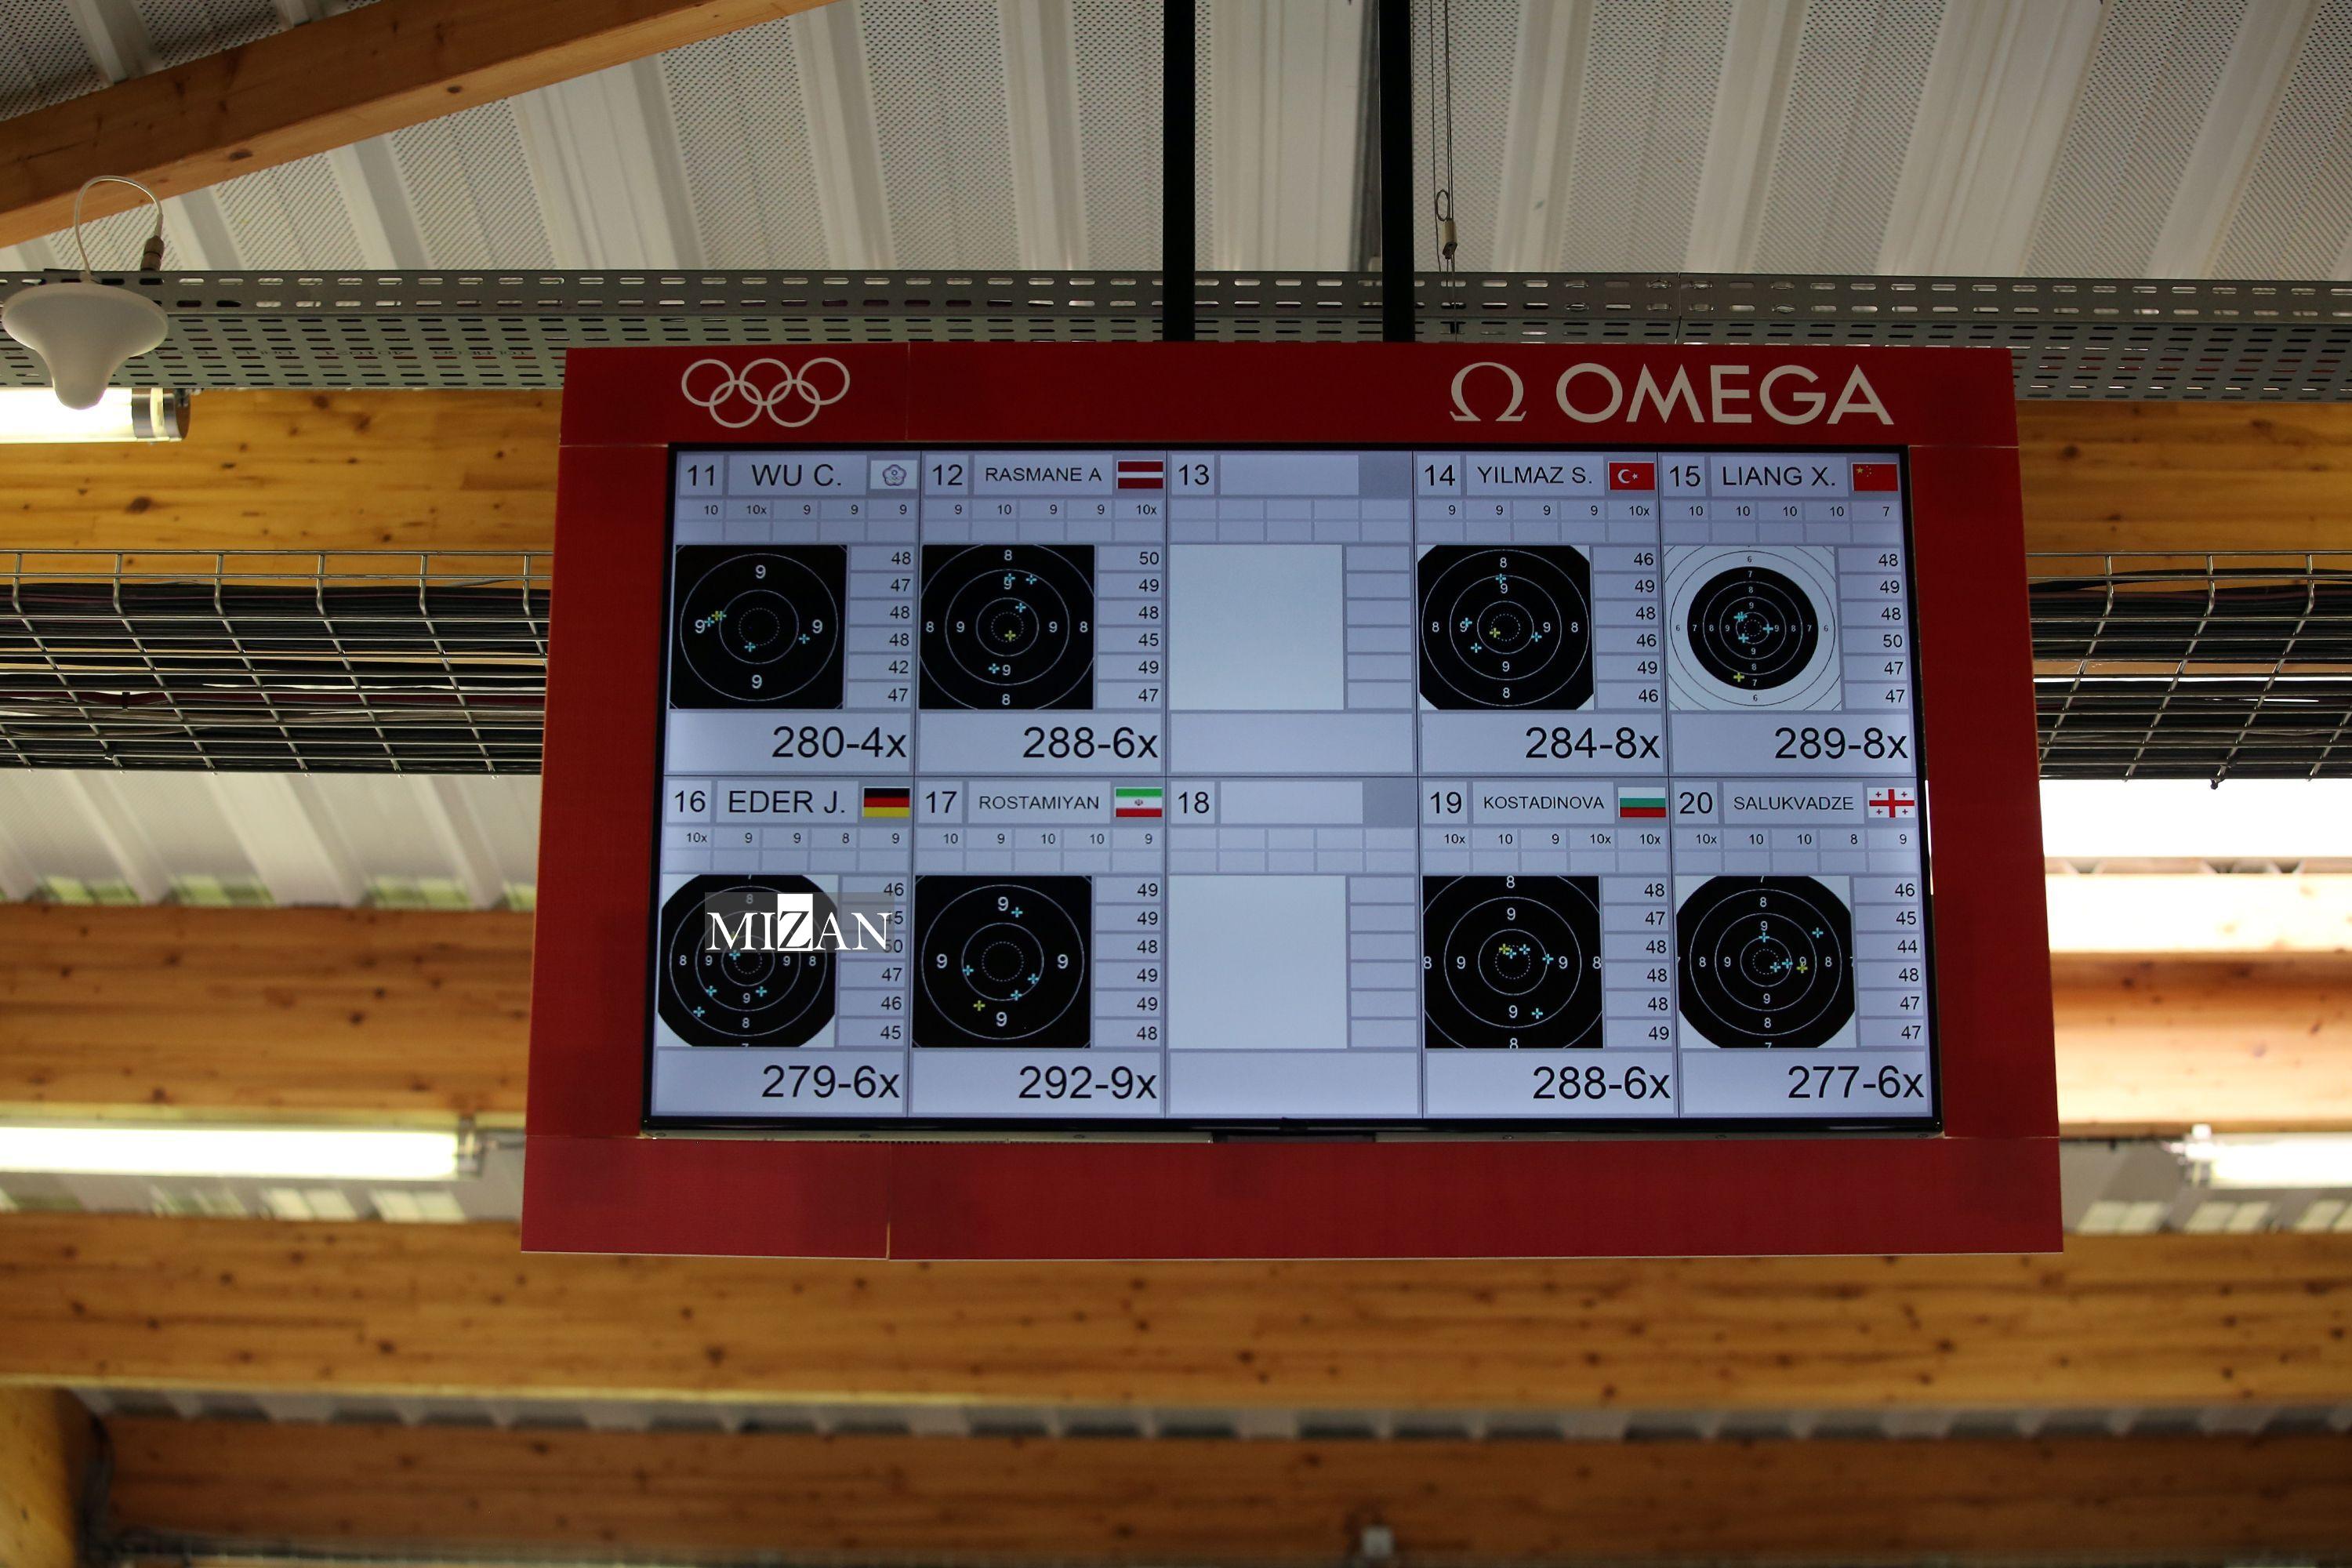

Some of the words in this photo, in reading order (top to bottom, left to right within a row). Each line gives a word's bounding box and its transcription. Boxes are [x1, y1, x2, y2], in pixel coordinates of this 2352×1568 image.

[1555, 362, 1895, 425] OMEGA
[688, 464, 714, 486] 11
[751, 464, 802, 487] WU
[814, 463, 841, 487] C.
[932, 463, 963, 486] 12
[985, 467, 1083, 481] RASMANE
[1088, 467, 1102, 481] A
[1178, 463, 1210, 486] 13
[1425, 464, 1456, 486] 14
[1477, 466, 1564, 484] YILMAZ
[1571, 466, 1592, 484] S.
[1669, 465, 1701, 488] 15
[1722, 466, 1802, 486] LIANG
[1811, 466, 1835, 486] X.
[704, 504, 718, 515] 10
[746, 504, 767, 515] 10x
[803, 504, 811, 515] 9
[851, 504, 858, 515] 9
[899, 504, 907, 515] 9
[954, 504, 963, 515] 9
[998, 503, 1012, 515] 10
[1049, 504, 1058, 515] 9
[1097, 504, 1105, 515] 9
[1136, 503, 1157, 515] 10x
[1448, 504, 1456, 516] 9
[1495, 505, 1504, 516] 9
[1543, 505, 1551, 516] 9
[1590, 505, 1599, 516] 9
[1629, 505, 1650, 517] 10x
[1689, 506, 1704, 517] 10
[1736, 506, 1751, 517] 10
[1783, 506, 1798, 517] 10
[1830, 506, 1845, 517] 10
[1882, 506, 1890, 517] 7
[891, 551, 911, 565] 48
[1004, 550, 1012, 561] 8
[1139, 551, 1160, 565] 50
[1501, 557, 1507, 568] 8
[1633, 552, 1654, 566] 46
[1878, 553, 1899, 567] 48
[756, 565, 765, 579] 9
[890, 578, 911, 592] 47
[1138, 579, 1160, 593] 49
[1500, 583, 1508, 593] 9
[1635, 579, 1655, 593] 49
[1879, 580, 1900, 593] 49
[889, 605, 910, 619] 48
[1138, 605, 1159, 619] 48
[1635, 606, 1656, 620] 48
[1881, 607, 1901, 621] 48
[695, 619, 705, 633] 9
[813, 619, 822, 633] 9
[926, 622, 934, 632] 8
[956, 622, 964, 632] 9
[1049, 622, 1057, 633] 9
[1080, 622, 1087, 633] 8
[1432, 622, 1439, 632] 8
[1544, 622, 1550, 632] 9
[1571, 622, 1578, 632] 8
[889, 633, 909, 647] 48
[1138, 633, 1159, 647] 45
[1636, 633, 1657, 648] 46
[1883, 633, 1903, 648] 50
[888, 660, 909, 674] 42
[1003, 665, 1011, 675] 9
[1138, 660, 1159, 674] 49
[1503, 662, 1509, 672] 9
[1637, 660, 1658, 675] 49
[1884, 661, 1904, 675] 47
[753, 675, 762, 688] 9
[887, 688, 909, 702] 47
[1002, 694, 1010, 705] 8
[1138, 688, 1159, 702] 47
[1503, 688, 1510, 698] 8
[1638, 688, 1659, 703] 46
[1885, 689, 1905, 703] 47
[771, 725, 907, 758] 280-4x
[1022, 726, 1159, 759] 288-6x
[1525, 726, 1661, 759] 284-8x
[1774, 727, 1908, 760] 289-8x
[674, 790, 706, 813] 16
[728, 790, 814, 813] EDER
[823, 790, 845, 814] J.
[926, 790, 957, 814] 17
[979, 796, 1099, 810] ROSTAMIYAN
[1178, 791, 1210, 814] 18
[1430, 791, 1462, 814] 19
[1483, 796, 1605, 809] KOSTADINOVA
[1679, 791, 1713, 815] 20
[1733, 796, 1854, 811] SALUKVADZE
[687, 832, 707, 843] 10x
[745, 832, 753, 844] 9
[793, 833, 801, 844] 9
[842, 833, 850, 844] 8
[891, 833, 900, 844] 9
[943, 833, 959, 844] 10
[997, 833, 1005, 844] 9
[1042, 833, 1056, 844] 10
[1090, 833, 1105, 844] 10
[1145, 833, 1152, 844] 9
[1444, 833, 1465, 844] 10x
[1498, 833, 1513, 845] 10
[1552, 833, 1559, 845] 9
[1590, 833, 1611, 844] 10x
[1639, 833, 1661, 845] 10x
[1696, 833, 1717, 844] 10x
[1749, 833, 1764, 845] 10
[1797, 833, 1812, 845] 10
[1850, 833, 1858, 845] 8
[1899, 833, 1907, 845] 9
[884, 882, 904, 897] 46
[1506, 876, 1515, 889] 8
[1137, 883, 1158, 897] 49
[1644, 883, 1665, 898] 48
[1894, 883, 1915, 897] 46
[998, 897, 1008, 911] 9
[1137, 911, 1158, 926] 49
[1507, 908, 1515, 920] 9
[1645, 911, 1666, 926] 47
[1896, 911, 1917, 925] 45
[1137, 939, 1158, 954] 48
[1646, 939, 1667, 954] 48
[1897, 939, 1918, 953] 44
[937, 954, 947, 968] 9
[1058, 954, 1068, 968] 9
[1423, 956, 1432, 970] 8
[1457, 956, 1465, 969] 9
[1559, 956, 1567, 969] 9
[881, 967, 902, 982] 47
[1137, 967, 1158, 982] 49
[1646, 967, 1668, 982] 48
[1898, 967, 1919, 982] 48
[880, 996, 902, 1011] 46
[1136, 996, 1158, 1011] 49
[1647, 996, 1668, 1011] 48
[1900, 996, 1920, 1011] 47
[1509, 1005, 1517, 1018] 9
[996, 1012, 1007, 1026] 9
[880, 1025, 902, 1040] 45
[1137, 1025, 1158, 1040] 48
[1648, 1025, 1670, 1040] 49
[1900, 1025, 1922, 1040] 47
[761, 1065, 900, 1098] 279-6x
[1018, 1065, 1157, 1100] 292-9x
[1533, 1065, 1671, 1100] 288-6x
[1788, 1065, 1925, 1098] 277-6x
